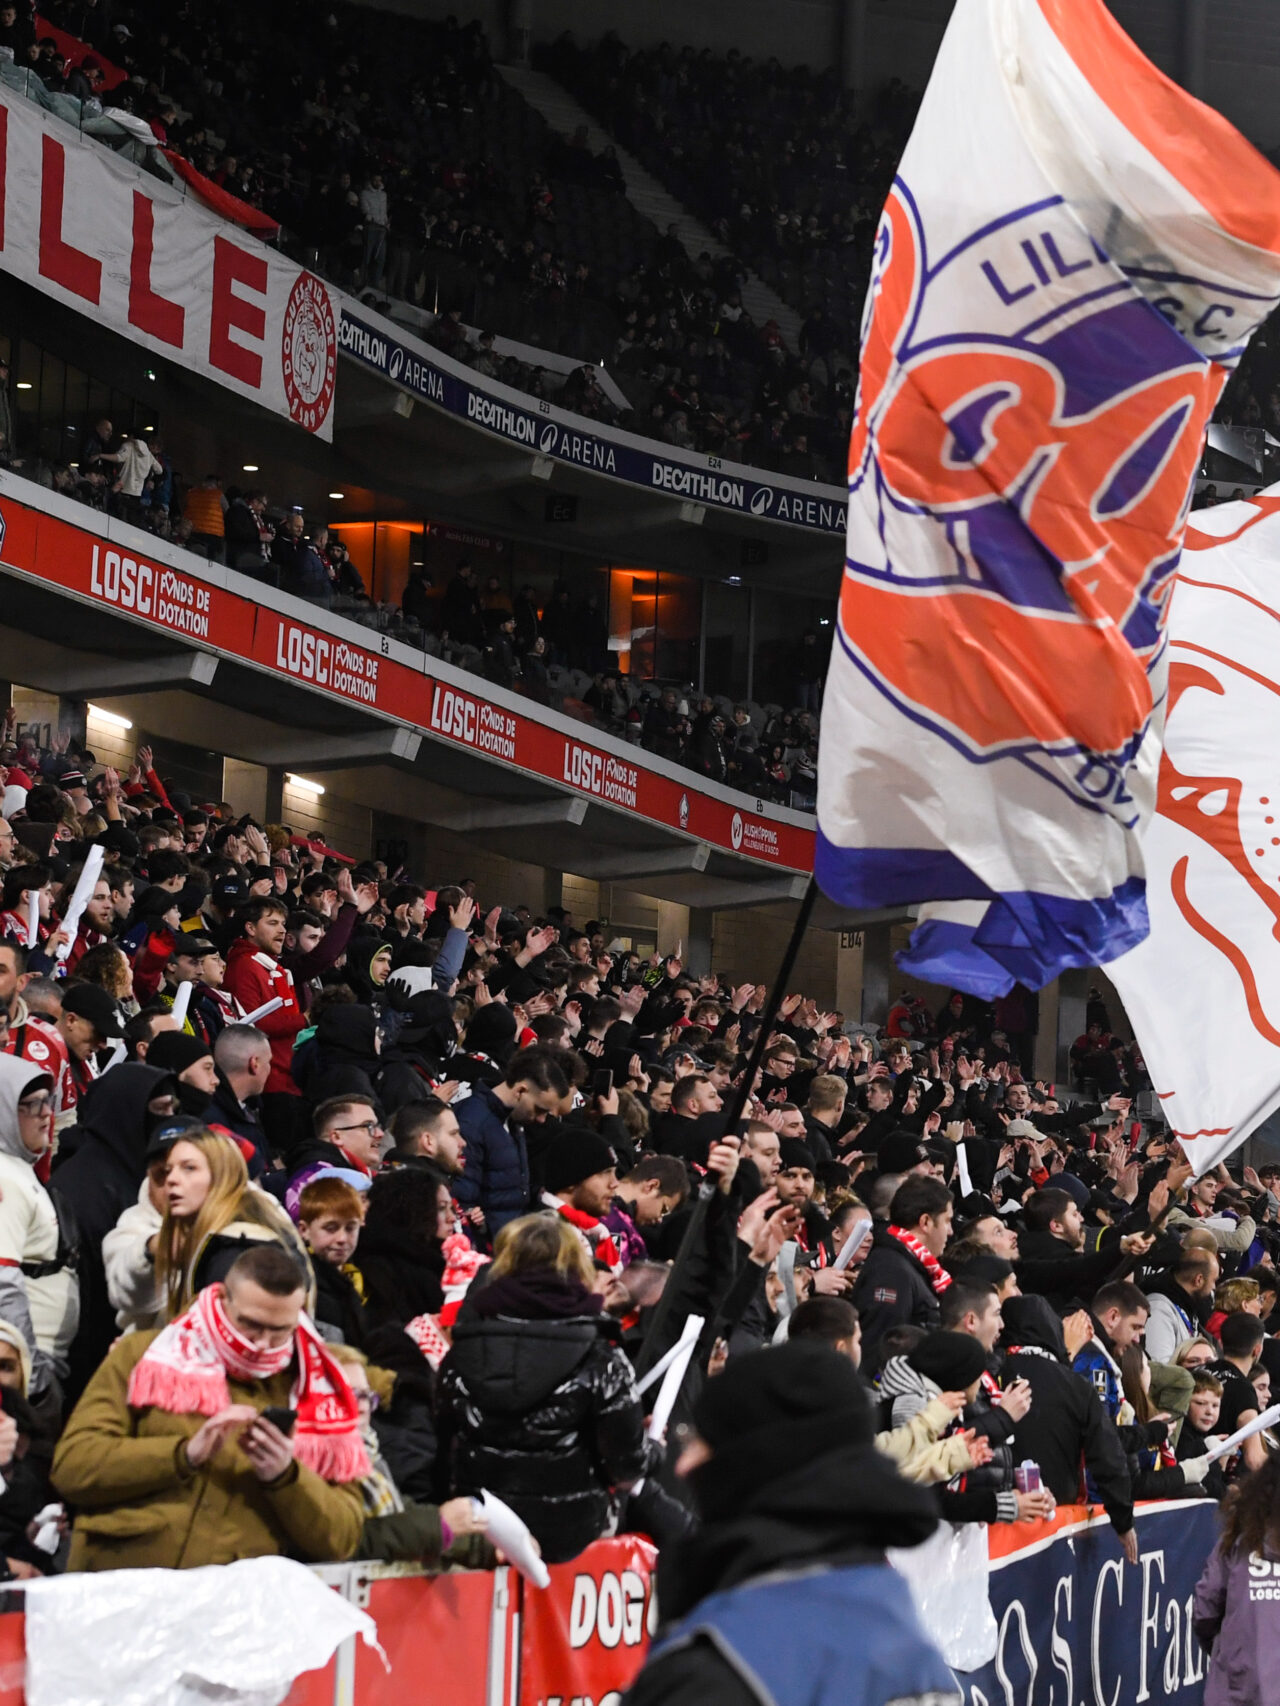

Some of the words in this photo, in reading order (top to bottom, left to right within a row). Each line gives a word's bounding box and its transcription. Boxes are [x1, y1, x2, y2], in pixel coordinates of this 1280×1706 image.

[404, 359, 444, 402] ARENA
[467, 392, 535, 445] DECATHLON
[560, 432, 617, 472] ARENA
[708, 456, 722, 469] E24
[653, 462, 744, 507] DECATHLON
[778, 496, 847, 529] ARENA
[90, 544, 153, 614] LOSC
[196, 589, 210, 612] DE
[158, 603, 209, 638] DOTATION
[277, 622, 329, 685] LOSC
[366, 659, 378, 680] DE
[334, 670, 377, 703] DOTATION
[431, 686, 475, 742] LOSC
[506, 719, 516, 738] DE
[479, 728, 515, 759] DOTATION
[563, 742, 601, 793] LOSC
[628, 770, 637, 788] DE
[605, 781, 636, 808] DOTATION
